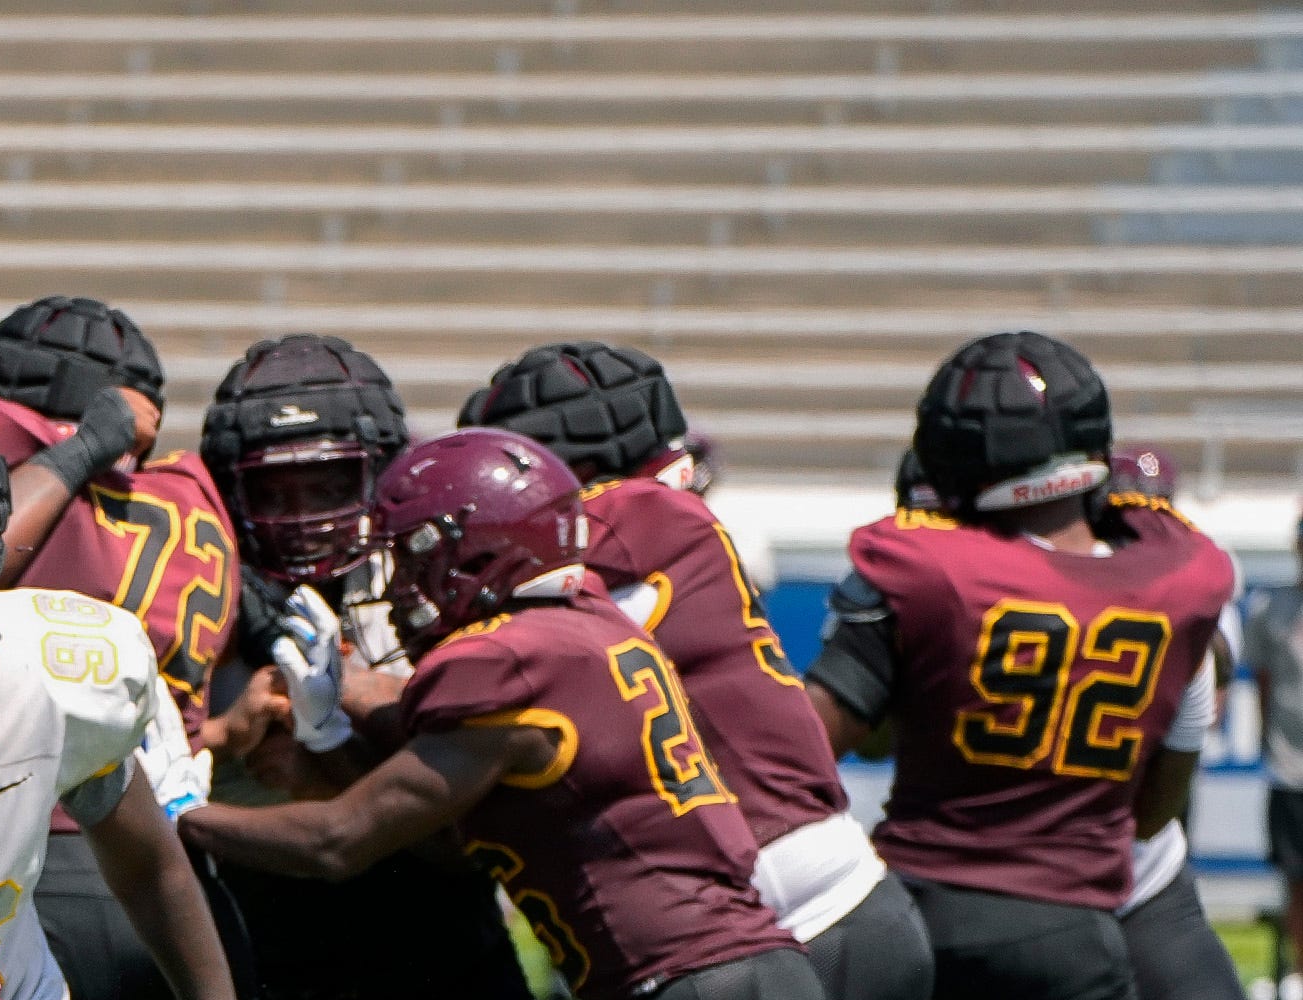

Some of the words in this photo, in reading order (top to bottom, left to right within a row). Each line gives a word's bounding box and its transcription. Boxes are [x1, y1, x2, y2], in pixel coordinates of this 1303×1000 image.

[90, 483, 236, 707] 72
[605, 638, 739, 817] 2
[952, 597, 1173, 781] 92
